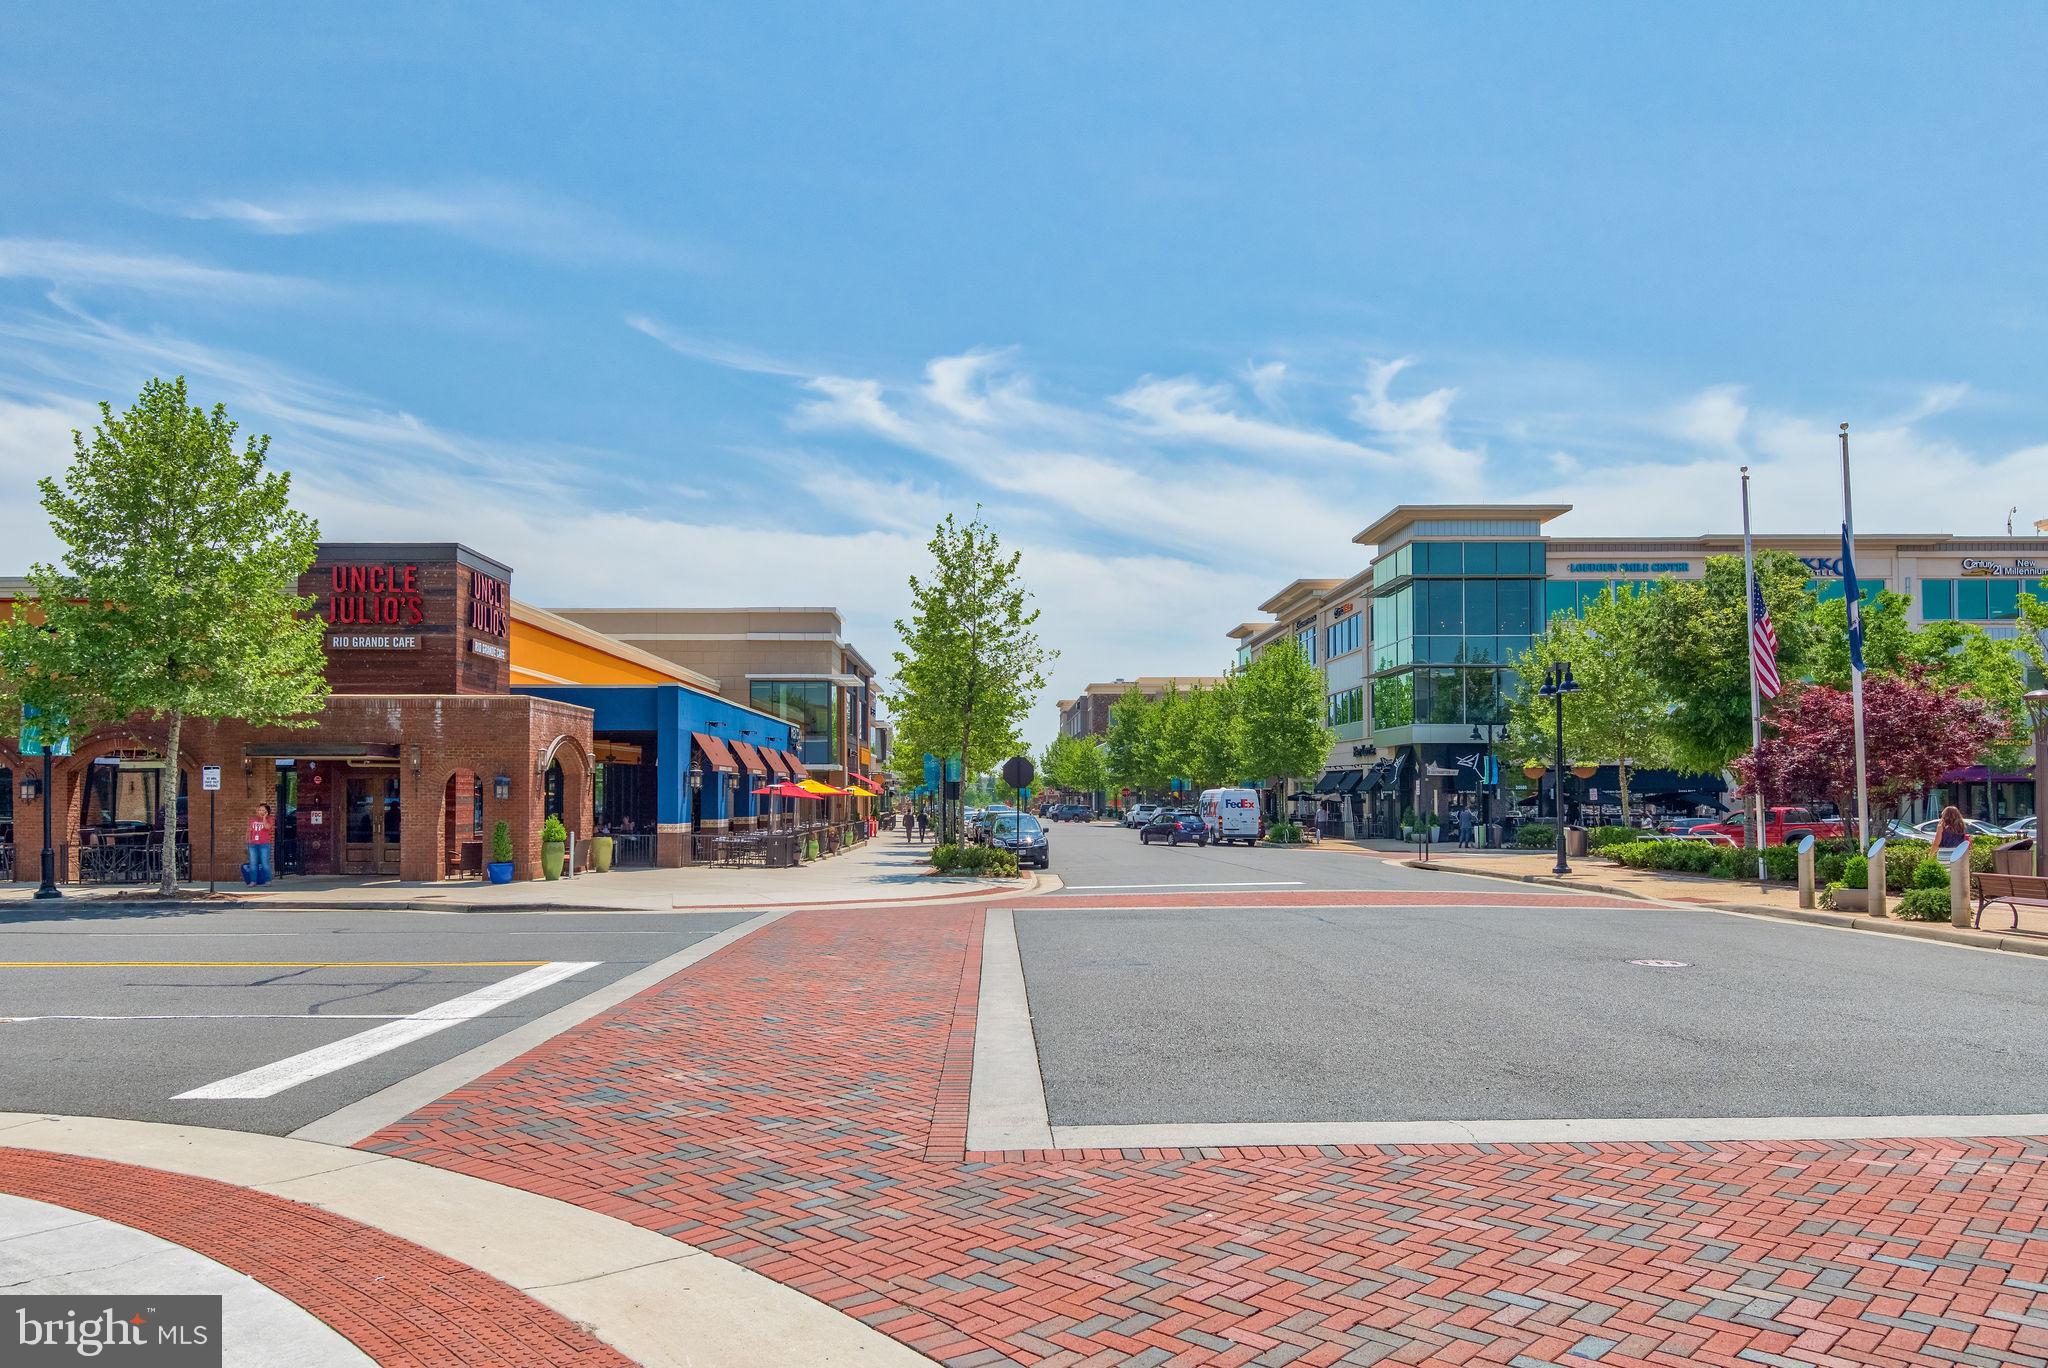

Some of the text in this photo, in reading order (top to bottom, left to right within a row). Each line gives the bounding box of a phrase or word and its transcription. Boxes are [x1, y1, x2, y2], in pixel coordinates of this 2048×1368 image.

[1651, 563, 1689, 572] CENTER
[1962, 558, 2002, 575] Century 21
[332, 566, 418, 593] UNCLE
[474, 572, 505, 609] UNCLE
[329, 596, 424, 625] JULIO'S
[472, 601, 506, 638] JULIO'S
[333, 636, 415, 648] RIO GRANDE CAFE
[1225, 799, 1255, 808] FedEx
